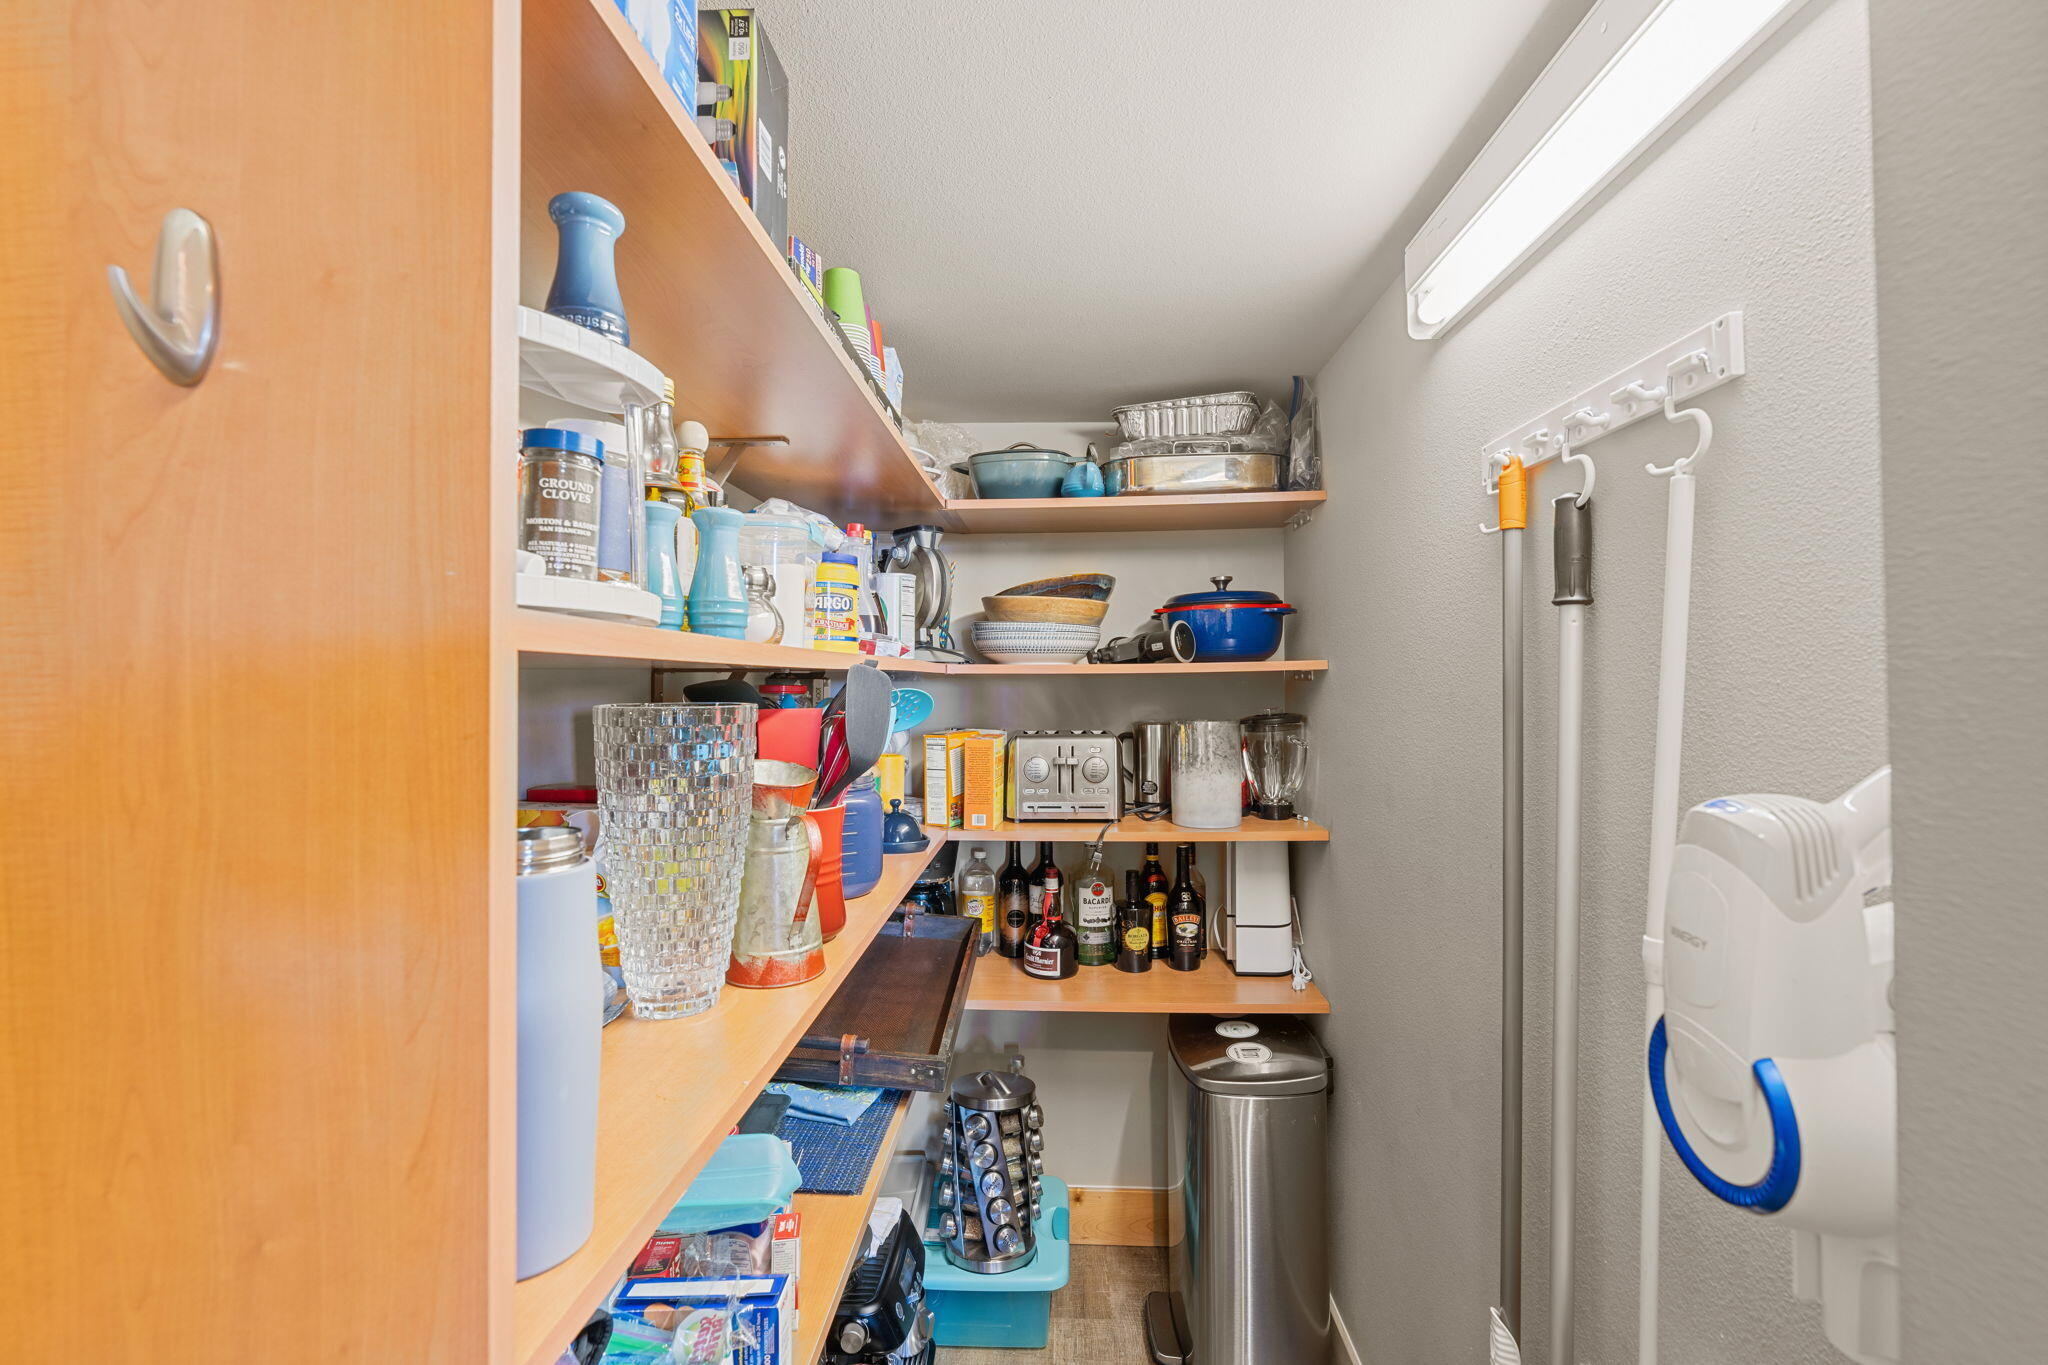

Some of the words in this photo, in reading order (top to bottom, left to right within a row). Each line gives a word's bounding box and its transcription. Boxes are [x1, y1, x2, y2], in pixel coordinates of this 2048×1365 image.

[539, 478, 594, 494] GROUND
[542, 488, 592, 504] CLOVES
[816, 596, 850, 610] ARGO
